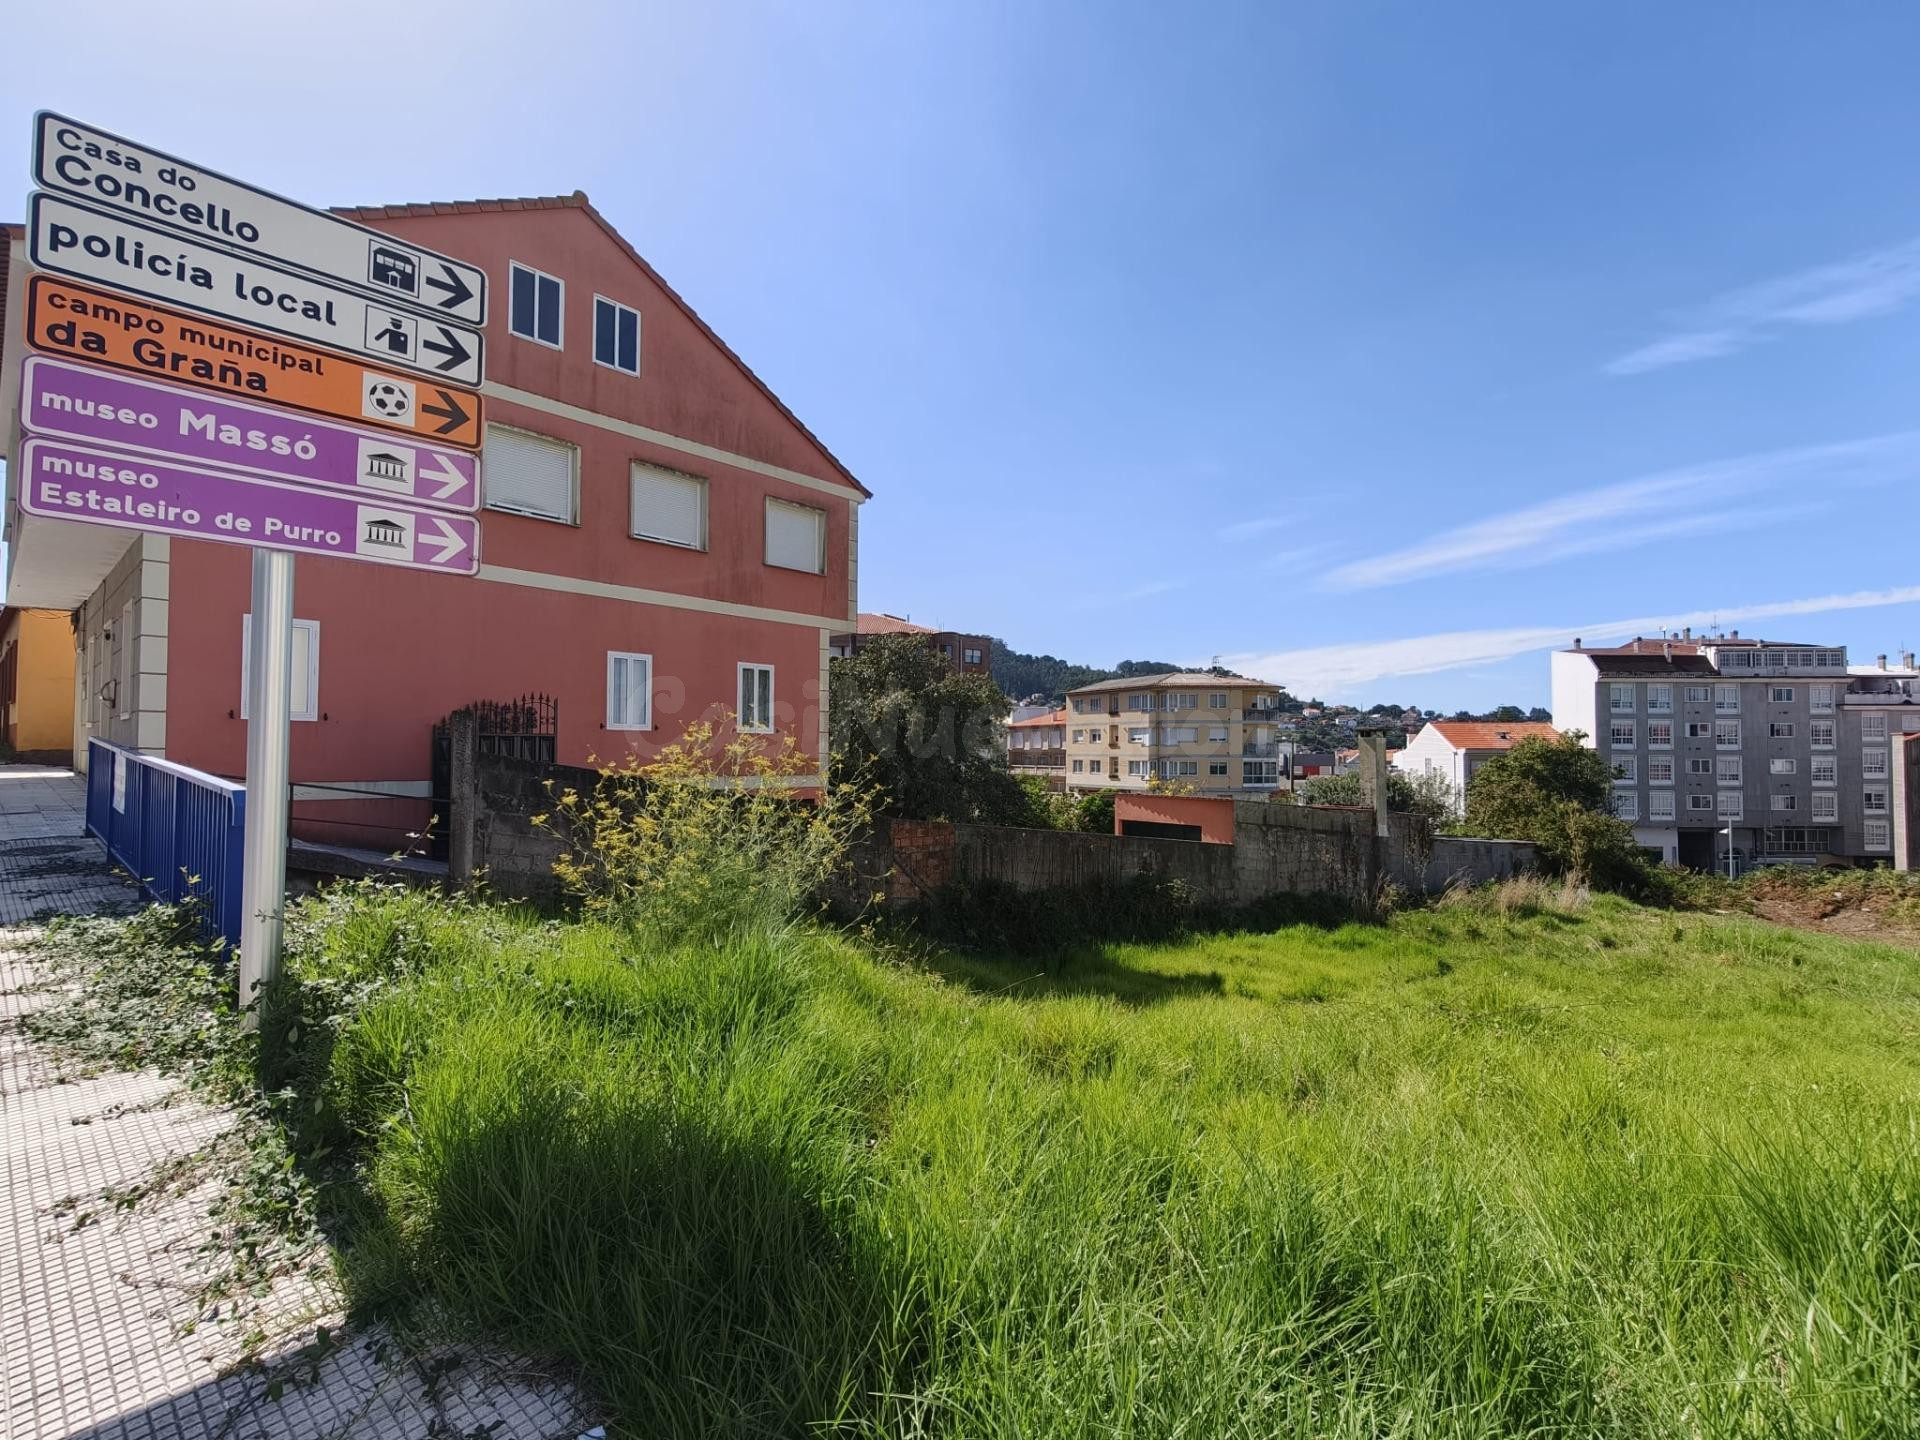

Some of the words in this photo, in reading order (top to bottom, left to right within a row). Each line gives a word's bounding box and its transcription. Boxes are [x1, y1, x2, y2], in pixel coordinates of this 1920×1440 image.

[56, 128, 142, 174] Casa
[158, 167, 196, 191] do
[55, 155, 260, 244] Concello
[49, 222, 213, 289] policía
[235, 272, 337, 326] local
[46, 321, 107, 355] da
[132, 338, 269, 393] Graña
[47, 293, 165, 335] campo
[179, 324, 324, 376] municipal
[41, 390, 158, 429] museo
[179, 408, 317, 461] Massó
[41, 452, 159, 490] museo
[40, 481, 201, 526] Estaleiro
[214, 511, 252, 534] de
[264, 518, 341, 546] Purro
